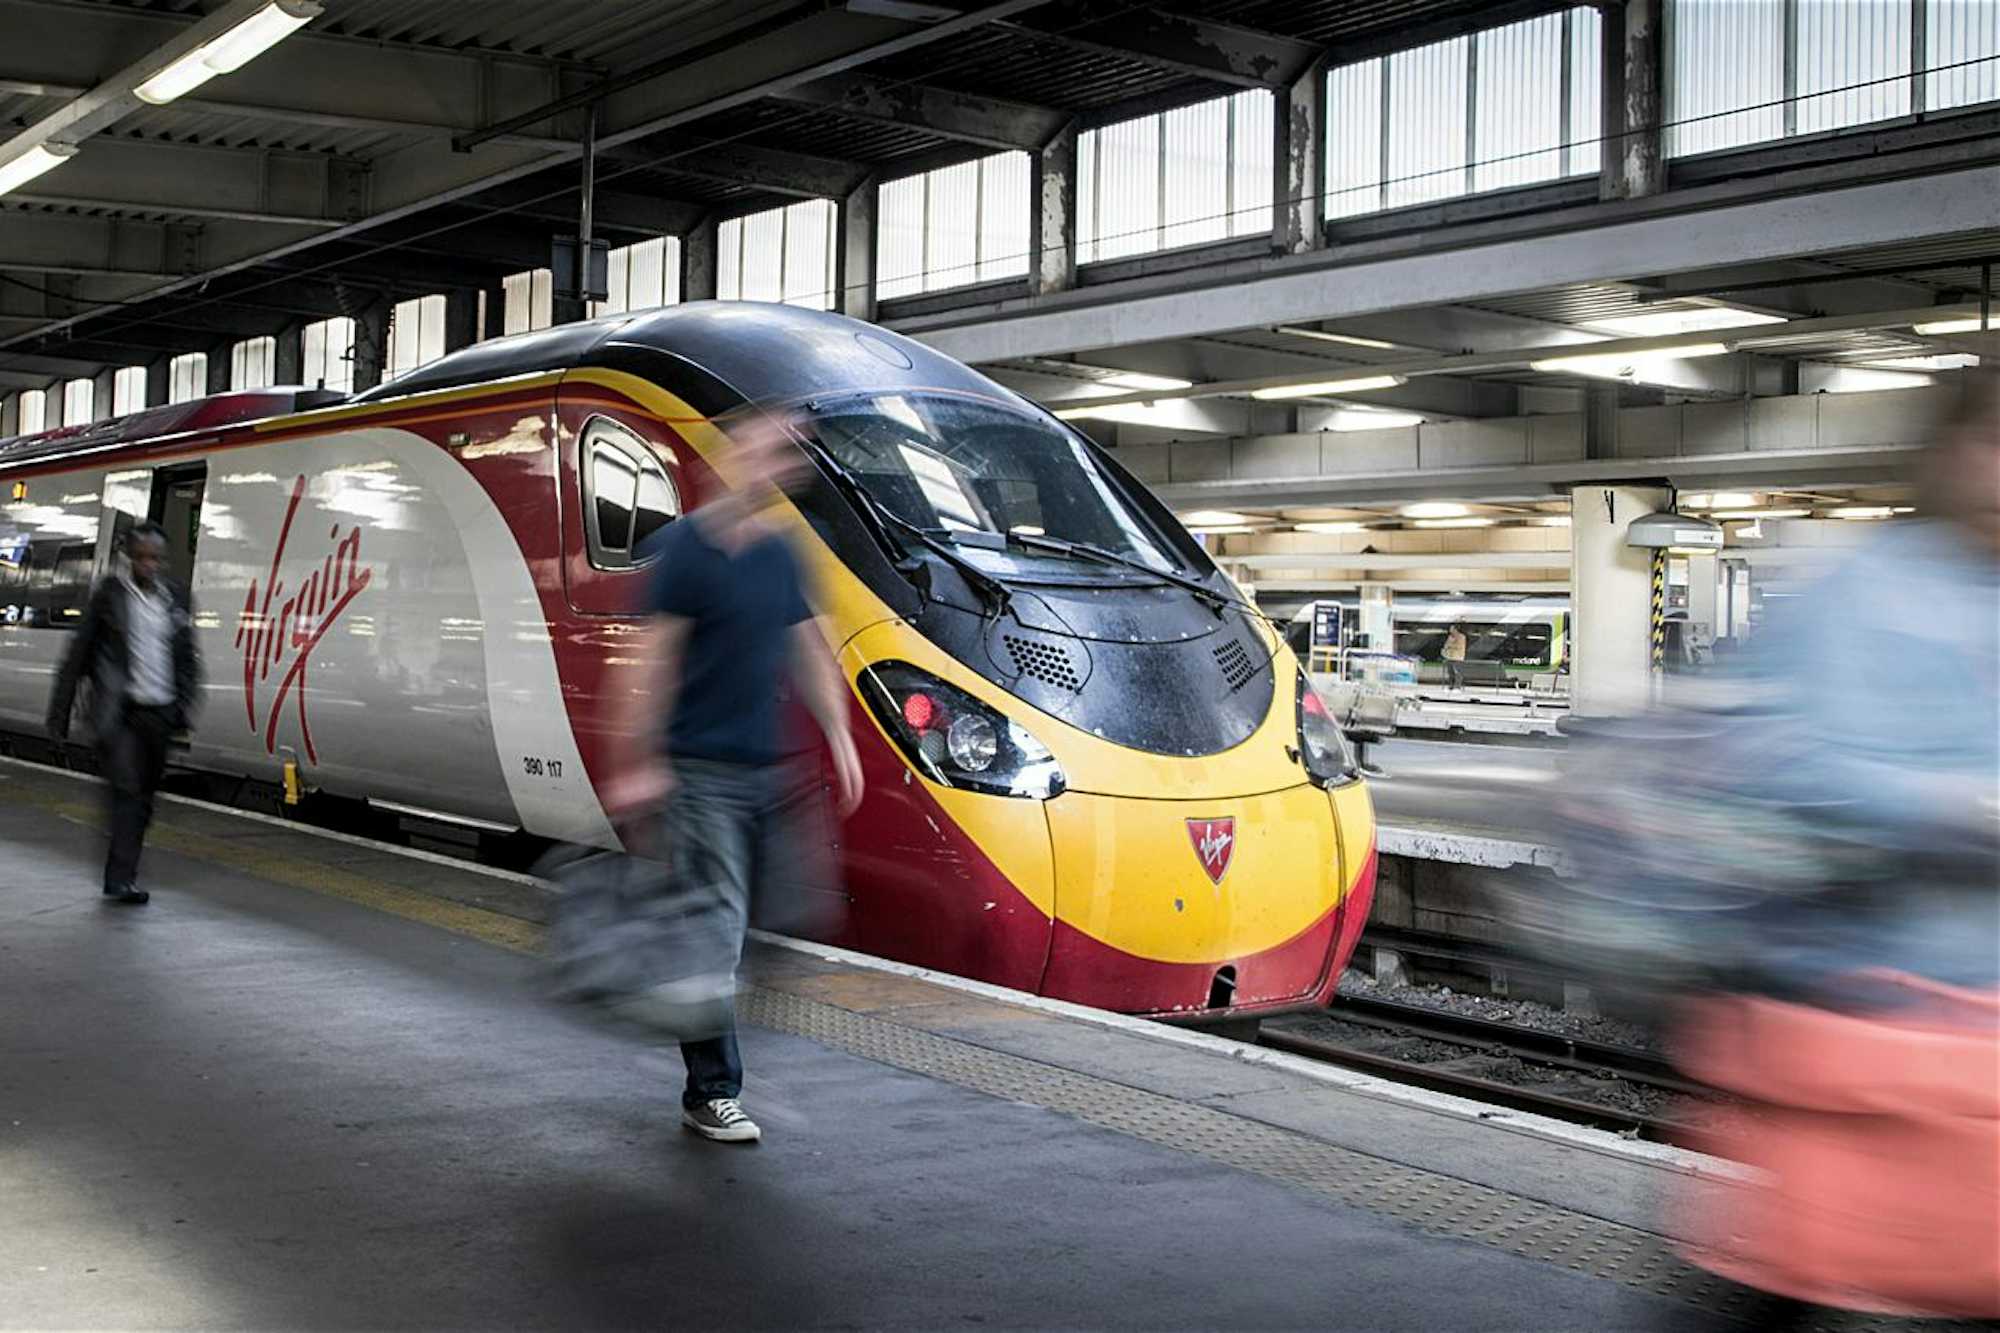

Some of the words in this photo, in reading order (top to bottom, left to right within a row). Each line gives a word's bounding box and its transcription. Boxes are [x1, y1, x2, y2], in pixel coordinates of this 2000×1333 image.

[235, 474, 371, 766] Virgin
[523, 756, 543, 776] 390
[548, 760, 562, 778] 117
[1200, 823, 1232, 867] Virgin
